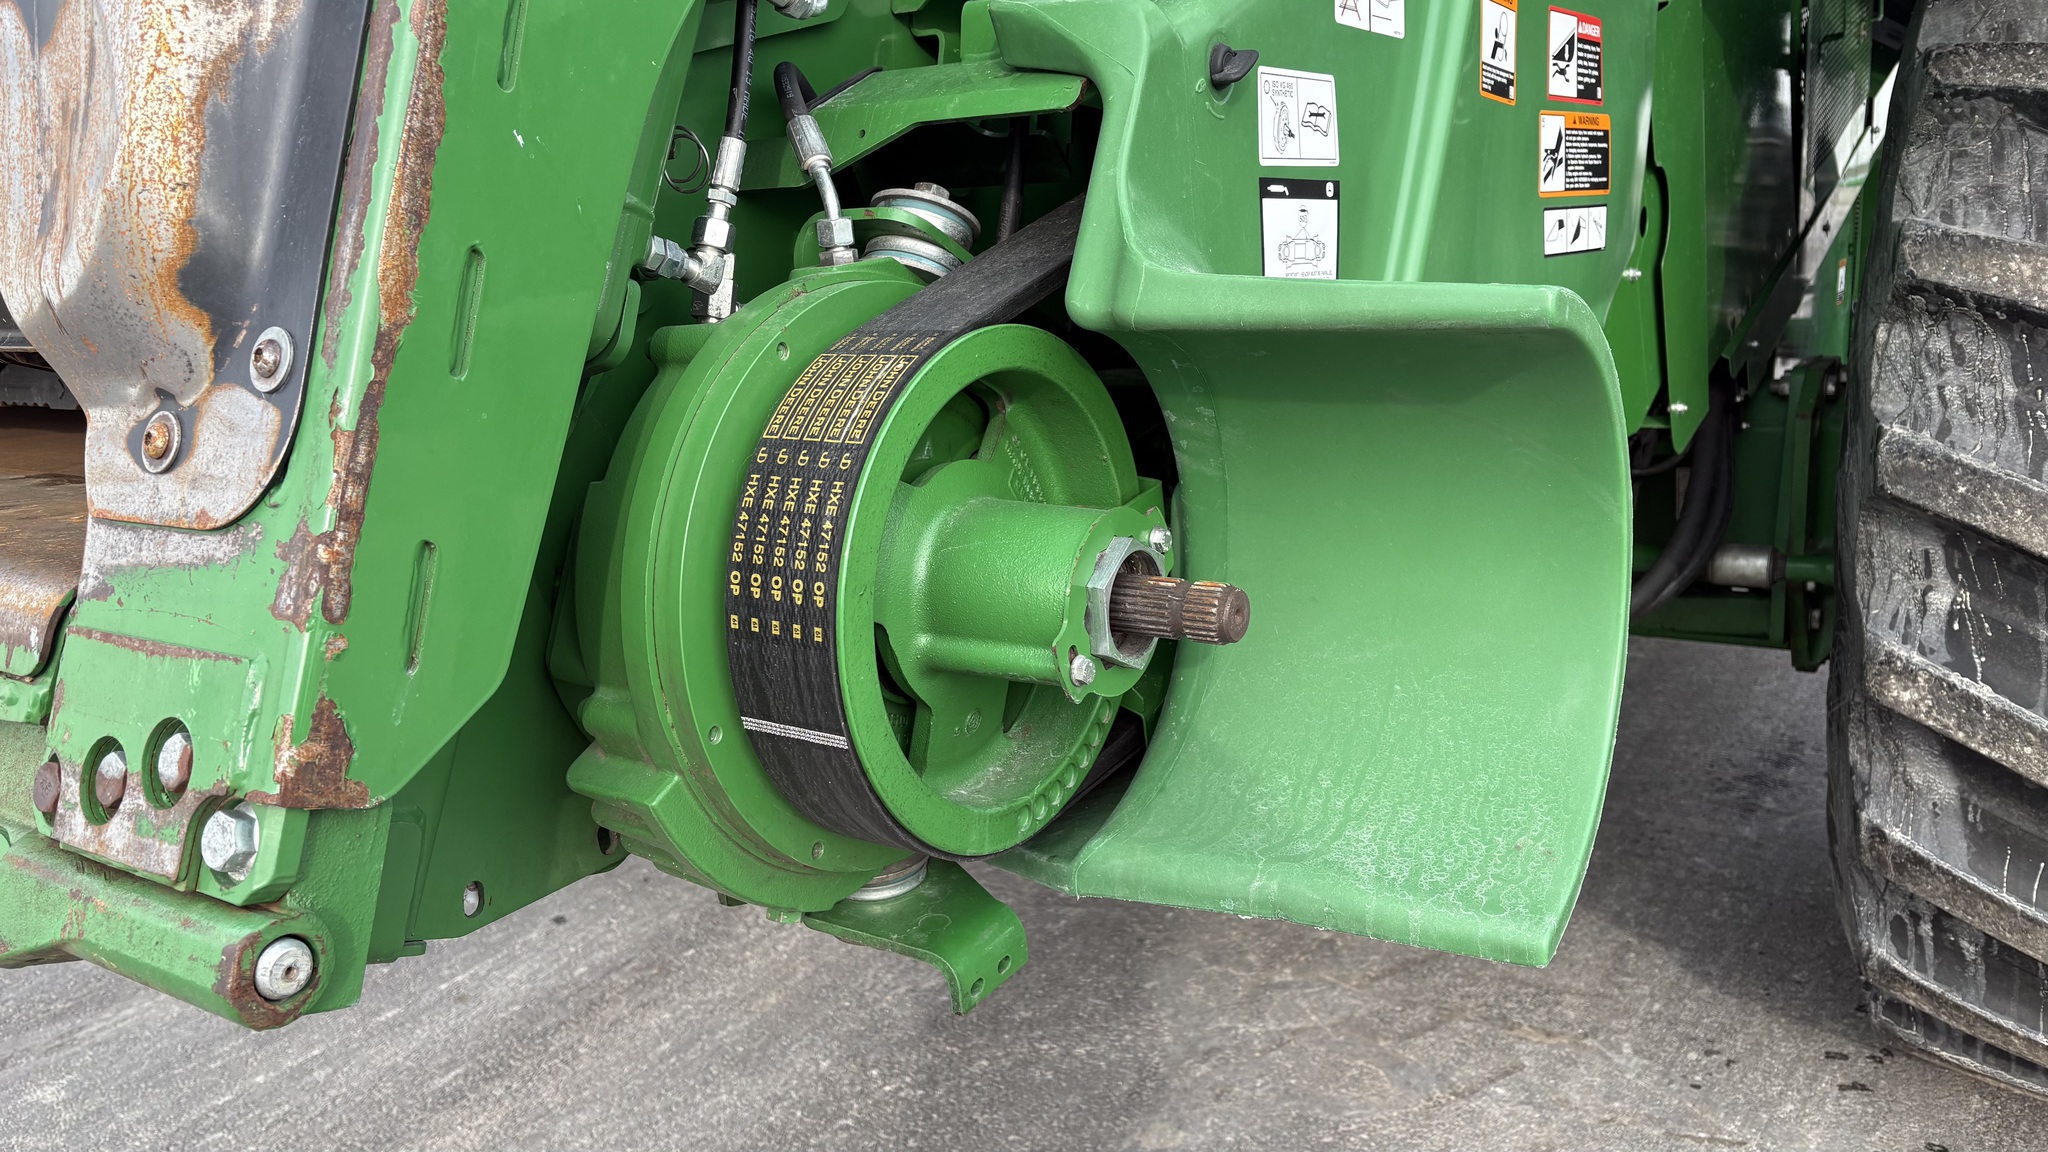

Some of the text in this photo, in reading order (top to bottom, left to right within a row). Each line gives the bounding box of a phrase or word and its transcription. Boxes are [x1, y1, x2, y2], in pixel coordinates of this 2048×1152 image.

[1582, 22, 1600, 38] DANGER
[740, 90, 750, 121] MADE
[1272, 88, 1294, 98] SYNTHETIC
[1578, 114, 1600, 126] WARNING
[818, 356, 848, 386] JOHN
[838, 356, 868, 387] JOHN
[858, 356, 889, 388] JOHN
[879, 358, 910, 388] JOHN
[768, 356, 828, 434] JOHN DEERE
[788, 388, 822, 436] DEERE
[810, 389, 842, 436] DEERE
[830, 390, 862, 438] DEERE
[850, 390, 884, 439] DEERE
[742, 474, 760, 508] HXE
[762, 476, 781, 510] HXE
[783, 477, 802, 512] HXE
[804, 480, 823, 514] HXE
[825, 481, 845, 516] HXE
[732, 512, 749, 562] 47152
[752, 513, 769, 564] 47152
[773, 515, 790, 567] 47152
[794, 518, 812, 570] 47152
[816, 520, 833, 573] 47152
[730, 570, 741, 596] OP
[750, 573, 762, 599] OP
[771, 576, 782, 602] OP
[792, 579, 804, 605] OP
[813, 582, 825, 608] OP
